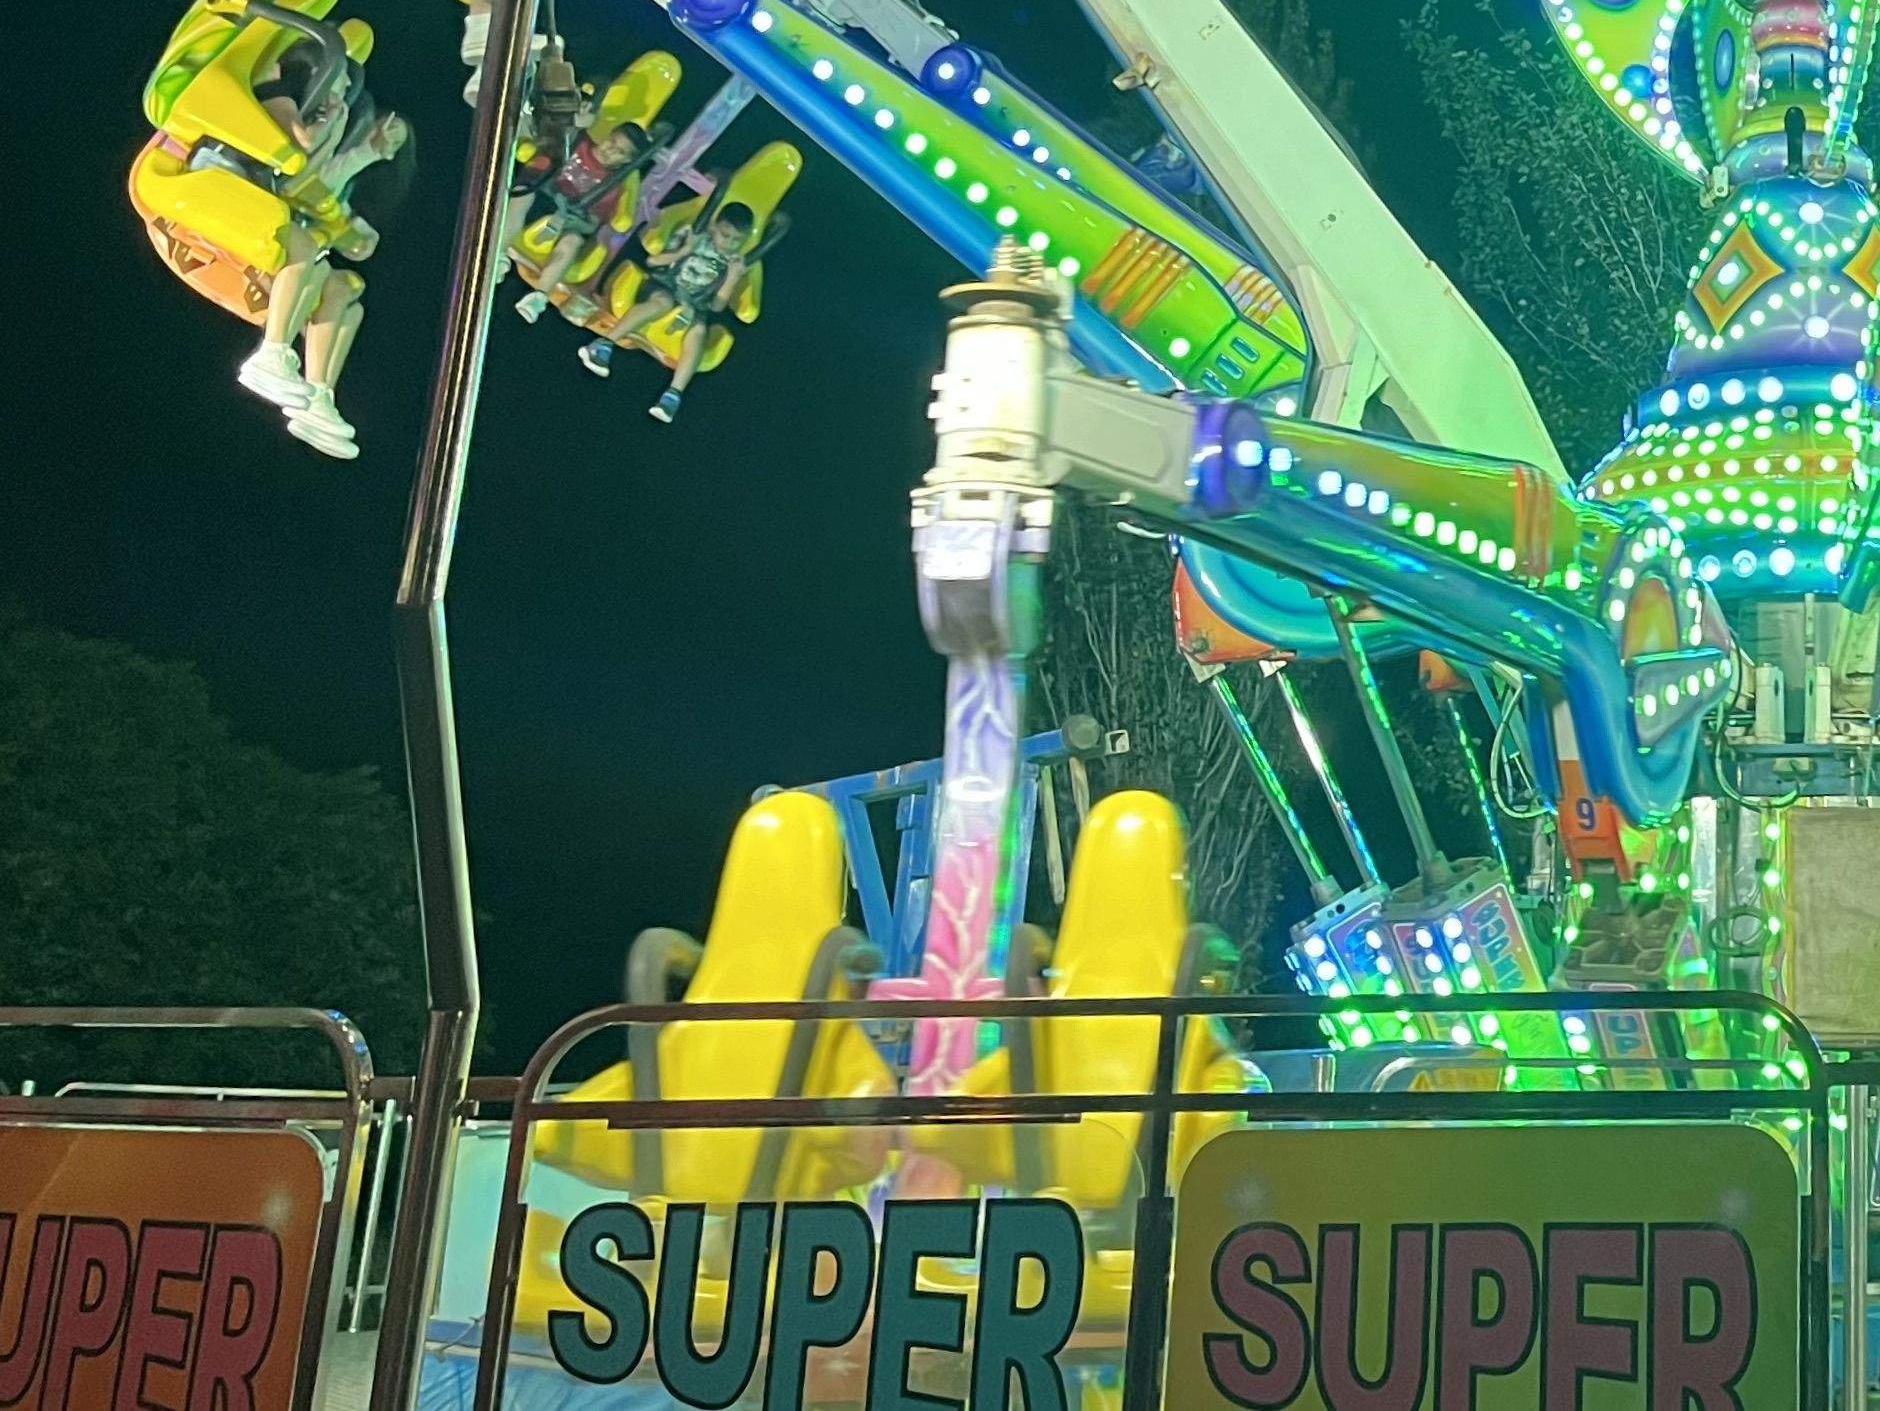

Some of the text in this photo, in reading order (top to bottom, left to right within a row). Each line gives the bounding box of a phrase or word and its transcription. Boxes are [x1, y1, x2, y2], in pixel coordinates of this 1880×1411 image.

[1576, 797, 1595, 832] 9
[548, 1198, 1084, 1411] SUPER
[1202, 1221, 1758, 1411] SUPER
